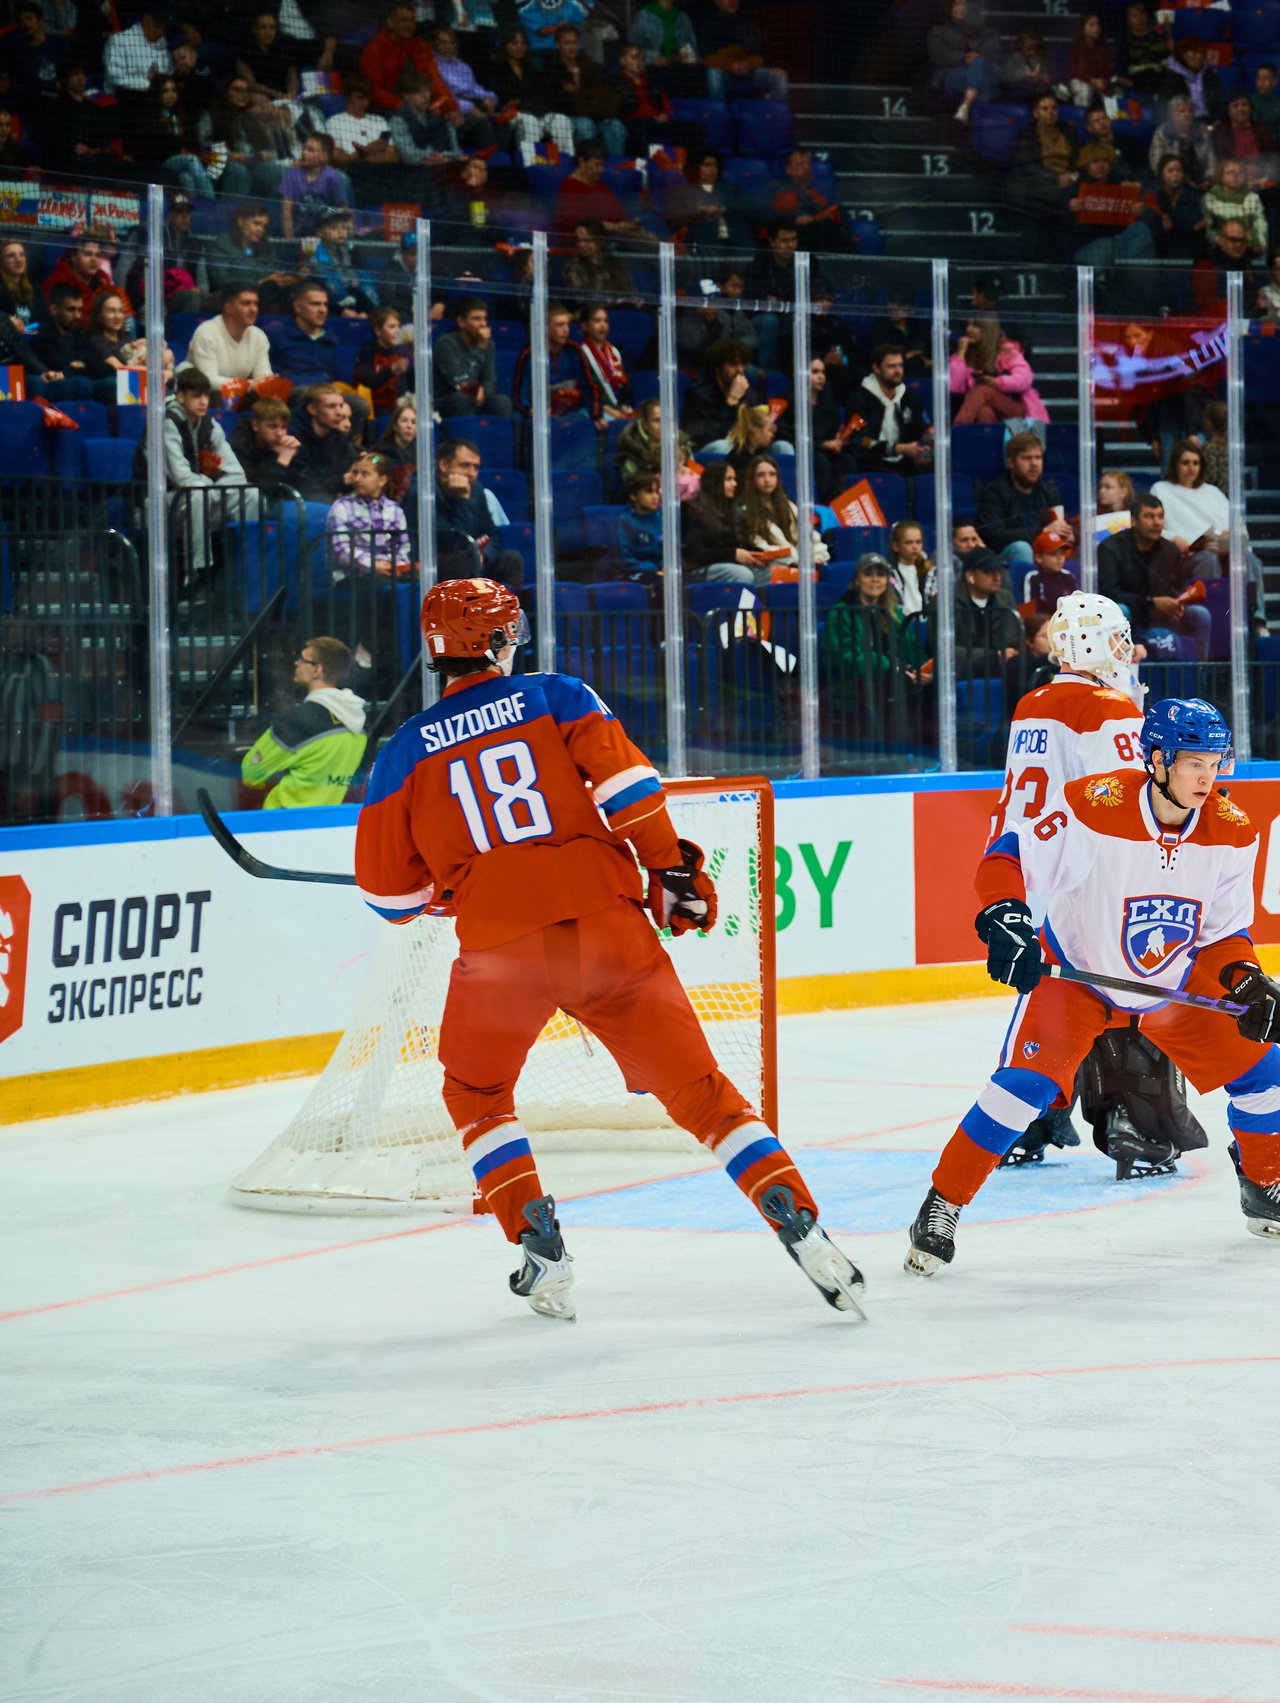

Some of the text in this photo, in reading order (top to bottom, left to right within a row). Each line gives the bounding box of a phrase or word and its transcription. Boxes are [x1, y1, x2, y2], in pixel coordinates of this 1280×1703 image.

[881, 97, 907, 119] 14
[922, 154, 950, 175] 13
[968, 211, 996, 234] 12
[1016, 273, 1039, 295] 11
[420, 691, 526, 753] SUZDORF
[1149, 731, 1164, 740] CCM
[448, 738, 554, 855] 18
[1034, 810, 1068, 842] 6
[665, 870, 691, 878] CCM
[1003, 912, 1035, 931] CC
[1128, 899, 1197, 926] СХЛ
[52, 889, 212, 969] СПОРТ
[47, 966, 204, 1024] ЭКСПРЕСС
[1234, 975, 1253, 995] CCM
